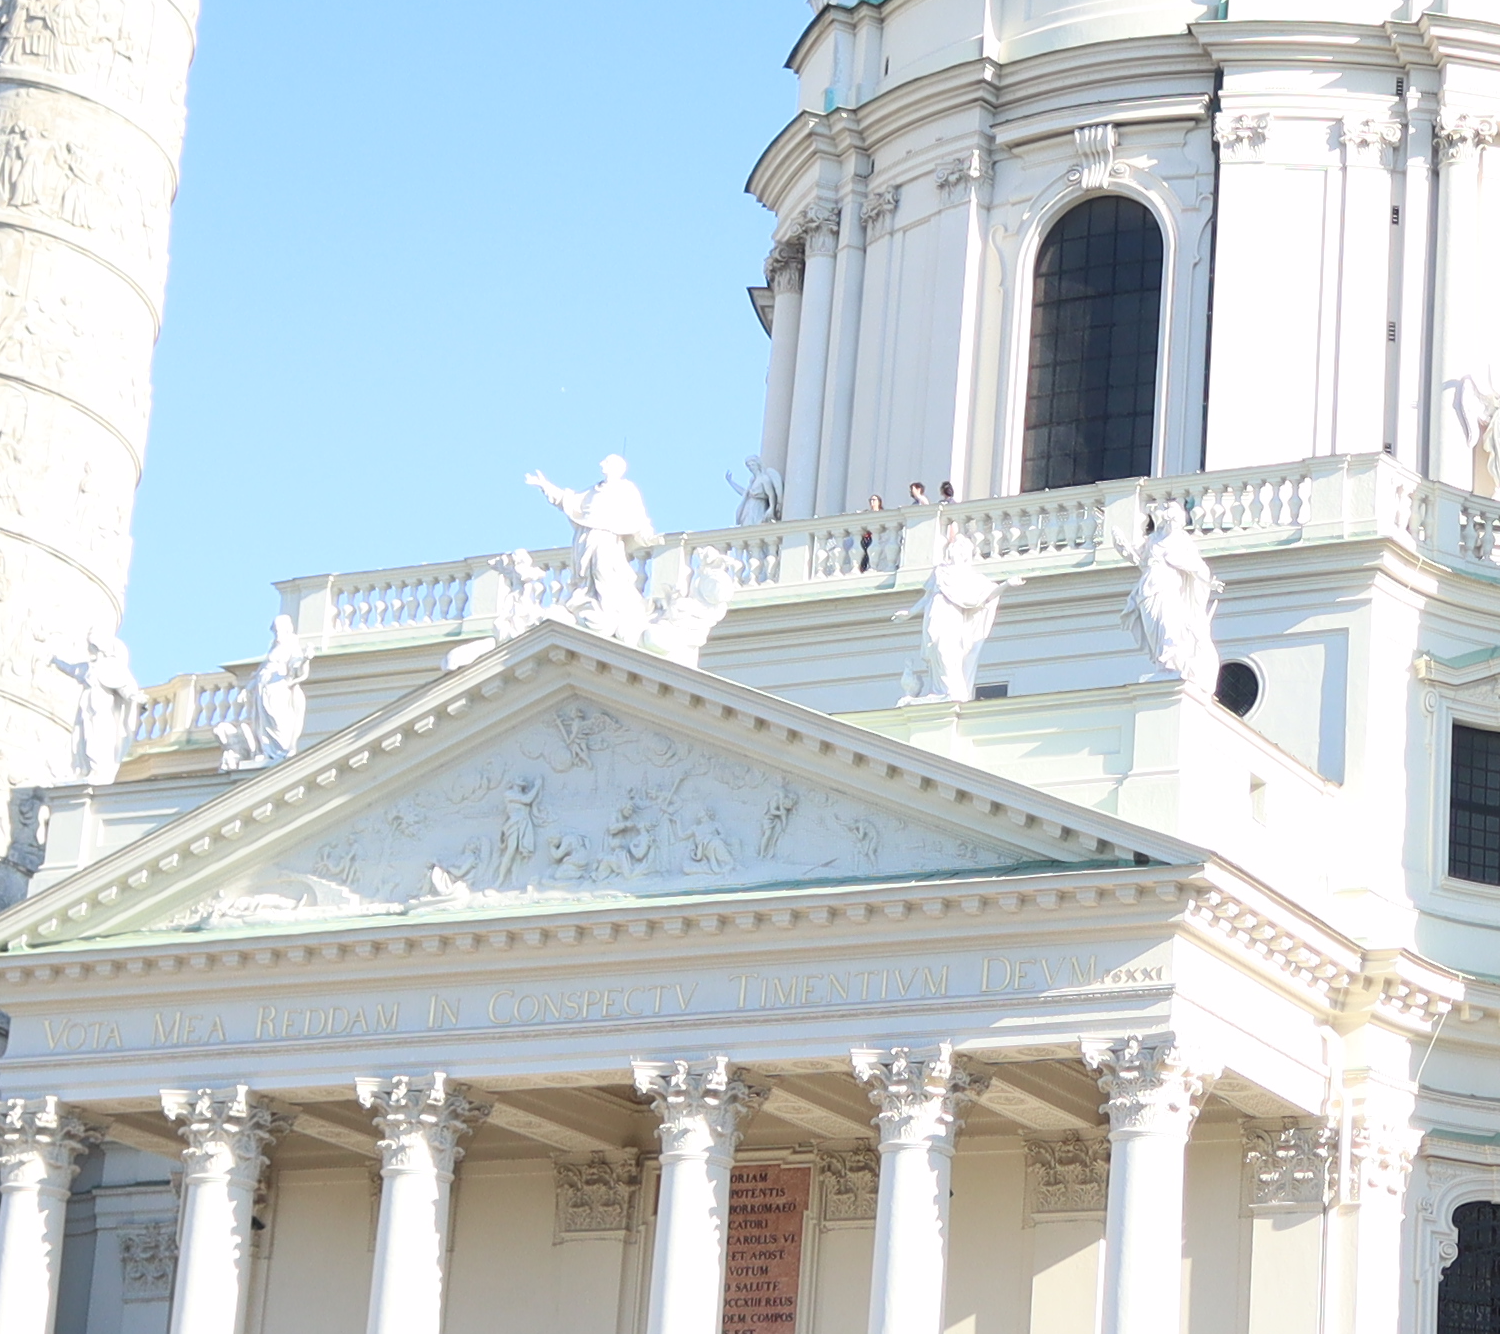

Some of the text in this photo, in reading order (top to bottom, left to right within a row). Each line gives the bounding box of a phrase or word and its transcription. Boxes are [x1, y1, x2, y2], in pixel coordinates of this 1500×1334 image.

[42, 1018, 123, 1050] VOTA
[151, 1010, 228, 1048] MEA
[255, 1001, 401, 1041] REDDAM
[427, 994, 461, 1028] IN
[486, 982, 699, 1025] CONSPECTV
[728, 964, 950, 1009] TIMENTIVM
[979, 954, 1097, 994] DEVM
[731, 1187, 786, 1199] POTENTIS
[728, 1219, 769, 1230] CATORI
[731, 1251, 746, 1261] ET
[729, 1265, 769, 1276] VOTUM
[765, 1295, 793, 1307] REUS
[750, 1312, 794, 1323] COMPOS
